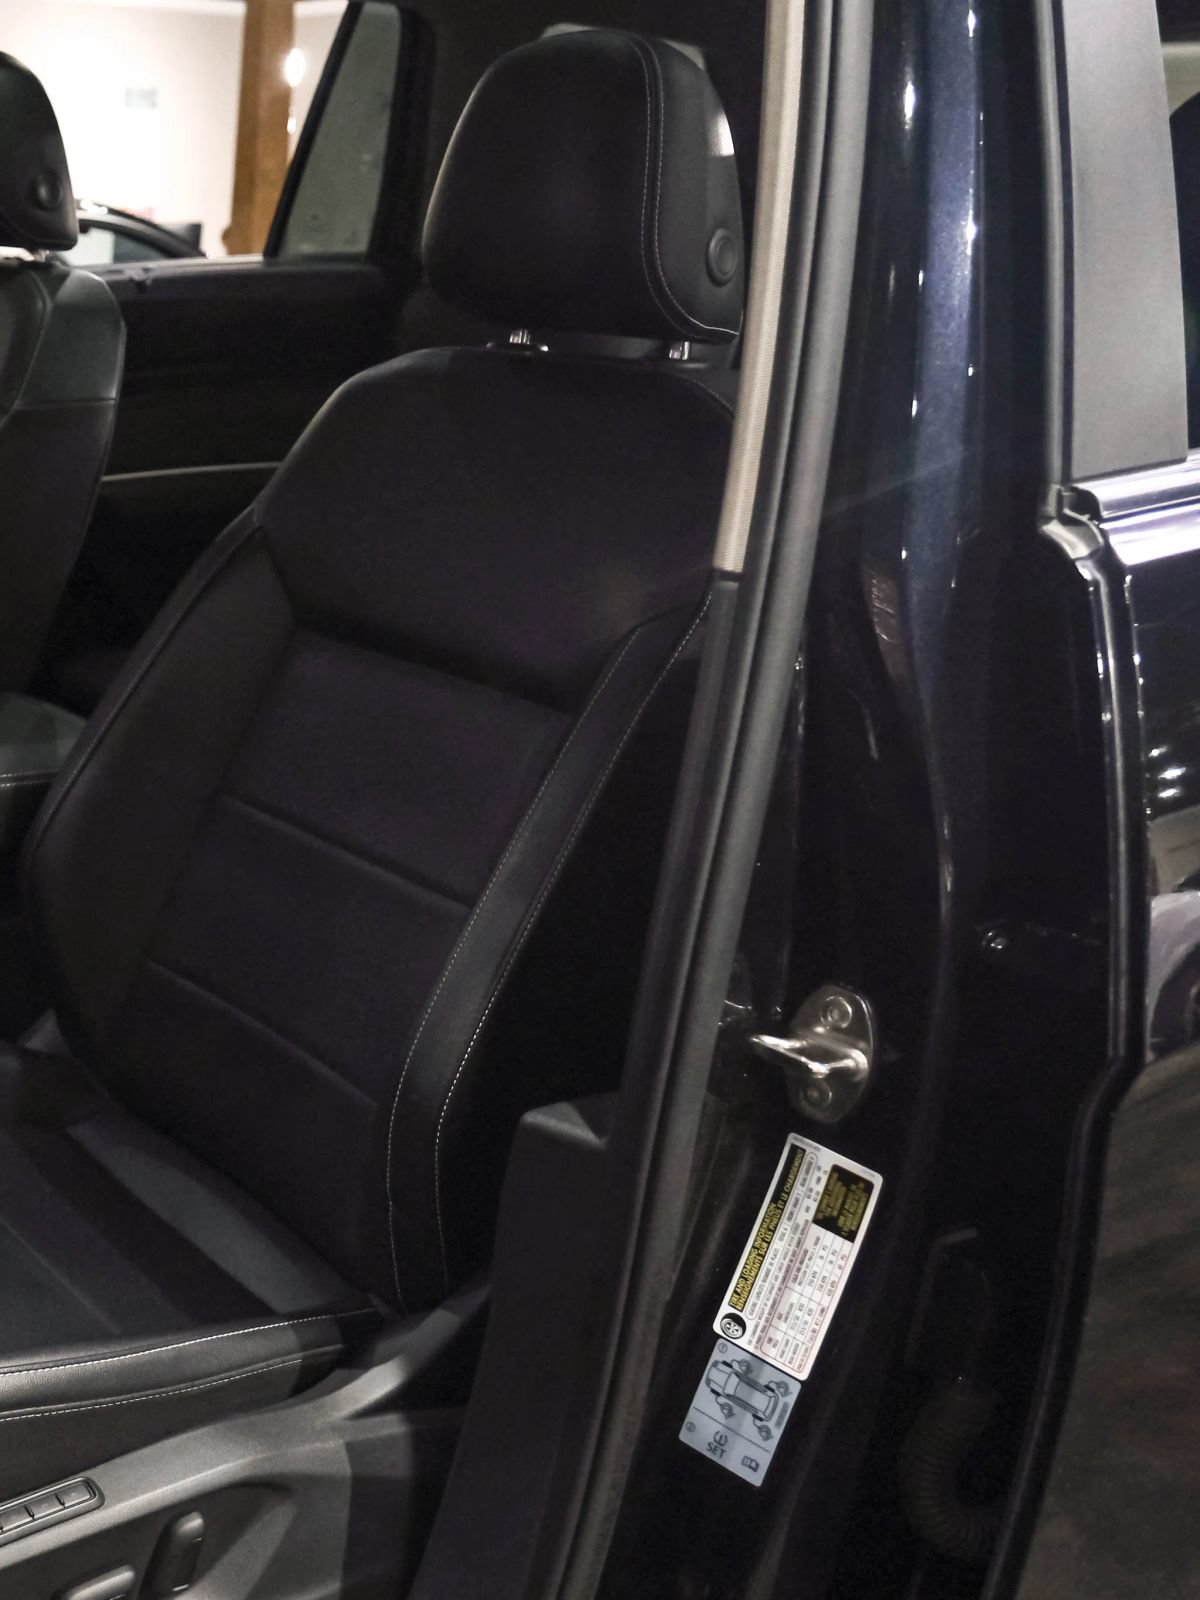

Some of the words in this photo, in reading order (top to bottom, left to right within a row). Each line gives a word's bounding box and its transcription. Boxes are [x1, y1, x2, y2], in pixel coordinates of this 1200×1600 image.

[782, 1148, 804, 1192] CHARGEMENT
[776, 1199, 784, 1208] ET
[779, 1192, 787, 1200] LE
[768, 1208, 781, 1230] PNEUS
[763, 1229, 773, 1241] LES
[729, 1292, 739, 1307] TIRE
[735, 1277, 745, 1293] AND
[741, 1247, 758, 1278] LOADING
[753, 1201, 776, 1248] INFORMATION
[758, 1241, 768, 1255] SUR
[735, 1254, 763, 1311] RENSEIGNEMENTS
[706, 1441, 727, 1459] SET
